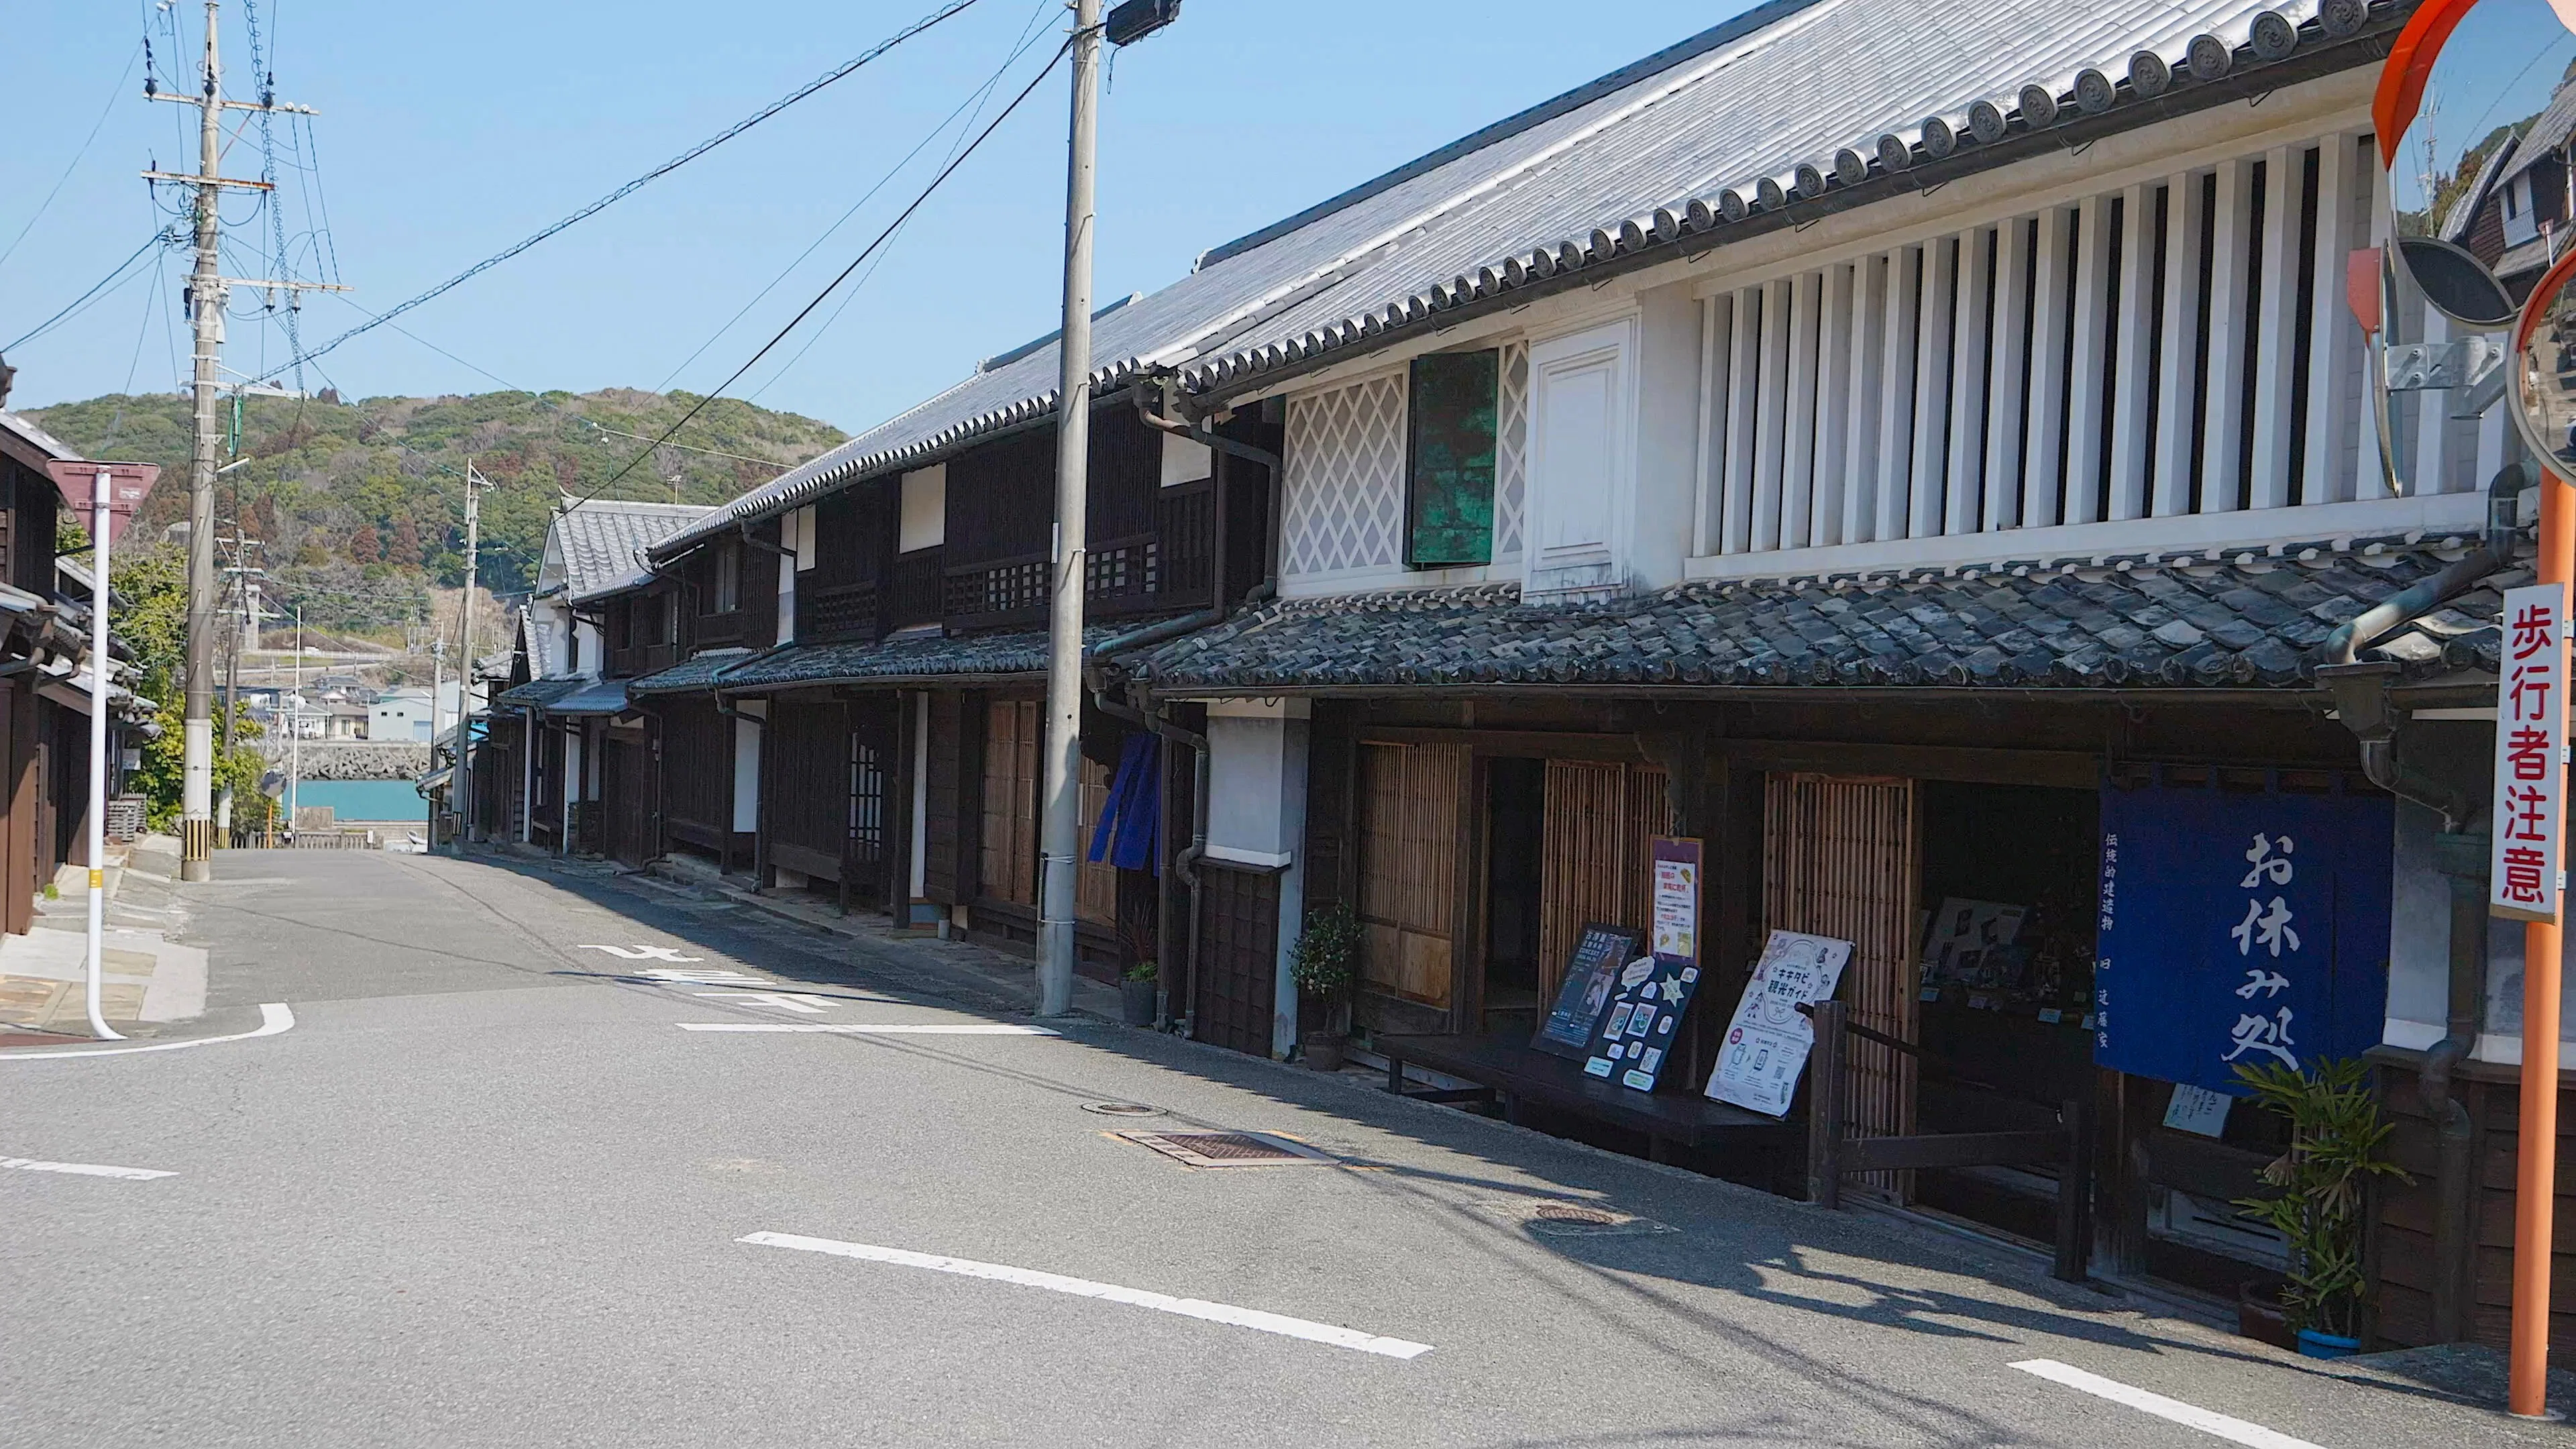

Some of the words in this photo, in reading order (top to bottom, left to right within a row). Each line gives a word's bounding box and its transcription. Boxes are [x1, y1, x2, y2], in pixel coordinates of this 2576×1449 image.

[2502, 604, 2552, 904] 歩行者注意
[2100, 833, 2118, 931] 伝統的建造物
[1778, 969, 1811, 984] キキタビ
[2099, 957, 2111, 971] 旧
[2220, 831, 2302, 1071] お休み処
[1768, 980, 1809, 1000] 観光ガイド
